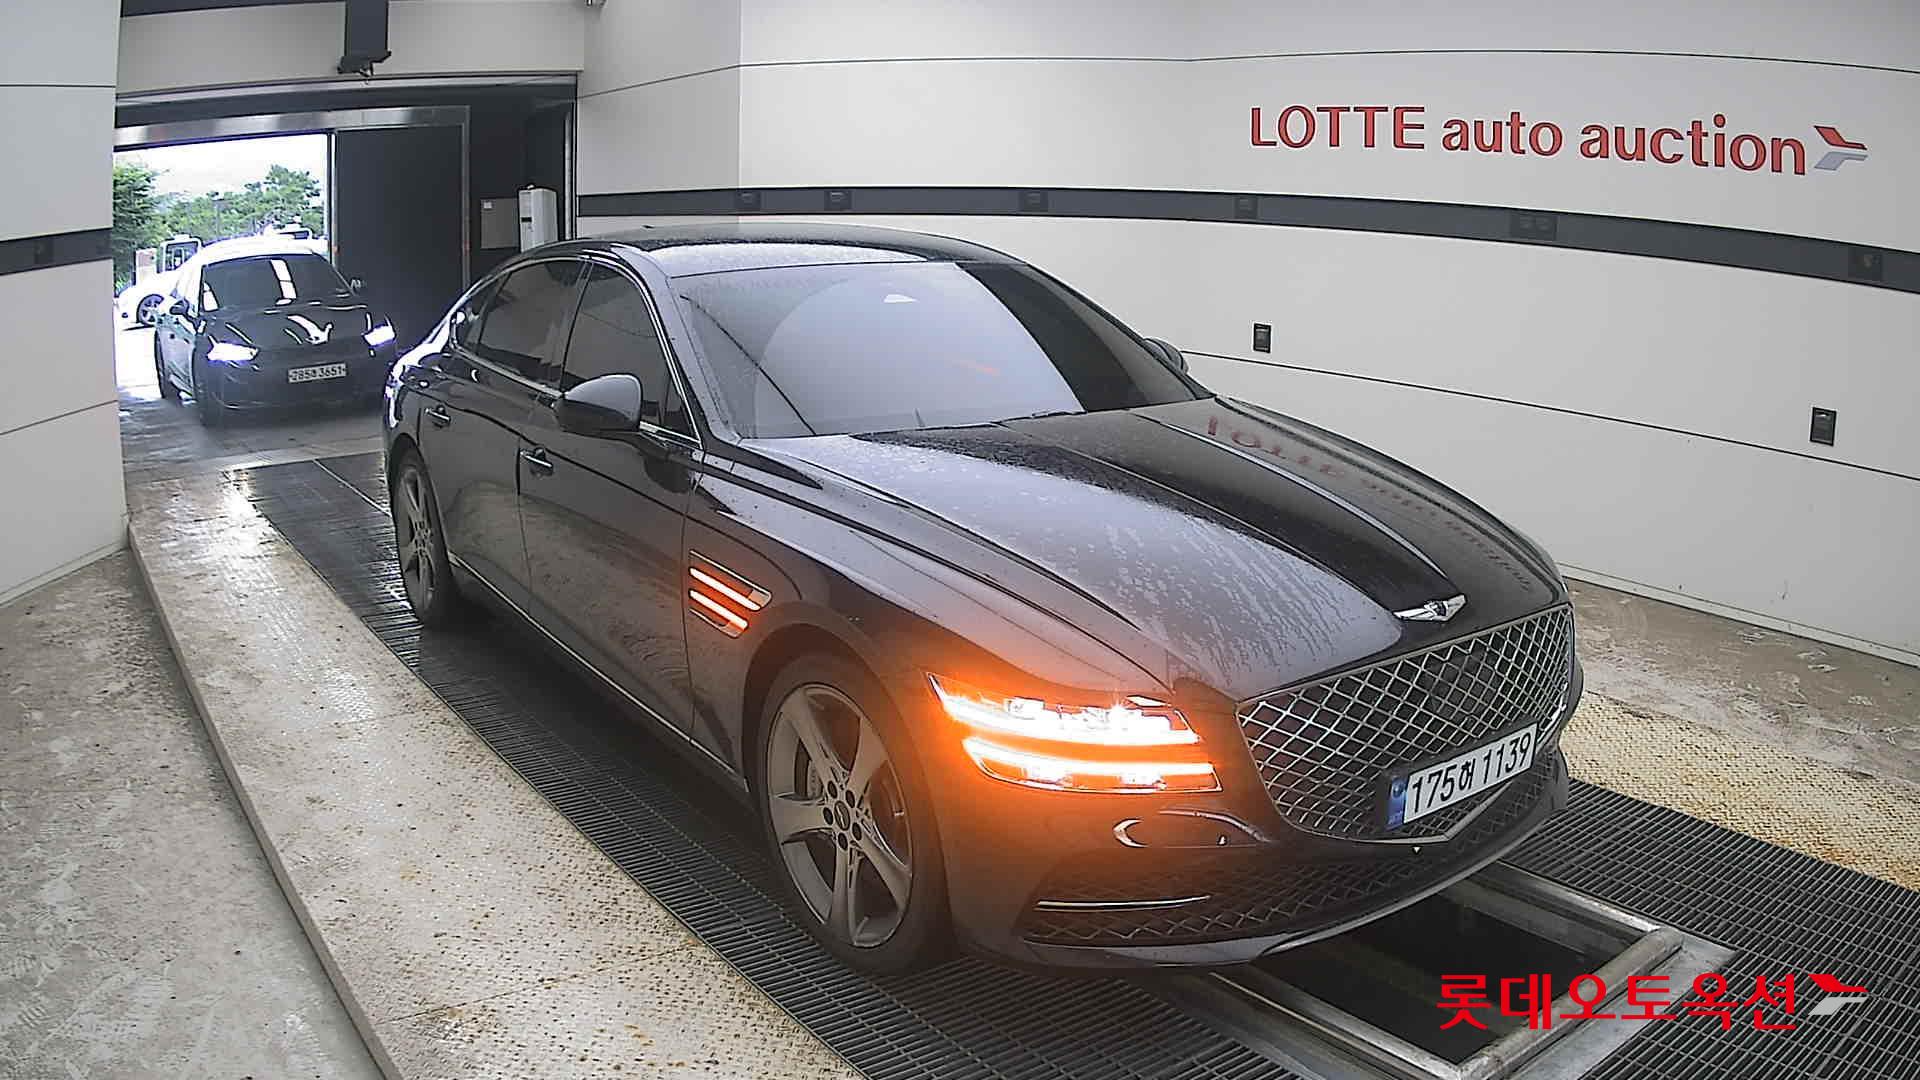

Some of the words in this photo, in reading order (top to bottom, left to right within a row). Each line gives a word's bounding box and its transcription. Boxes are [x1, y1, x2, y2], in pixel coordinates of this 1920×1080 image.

[1250, 104, 1425, 149] LOTTE
[1441, 110, 1564, 157] auto
[1578, 113, 1807, 176] auction
[1412, 757, 1477, 815] 175허
[1483, 731, 1533, 785] 1139
